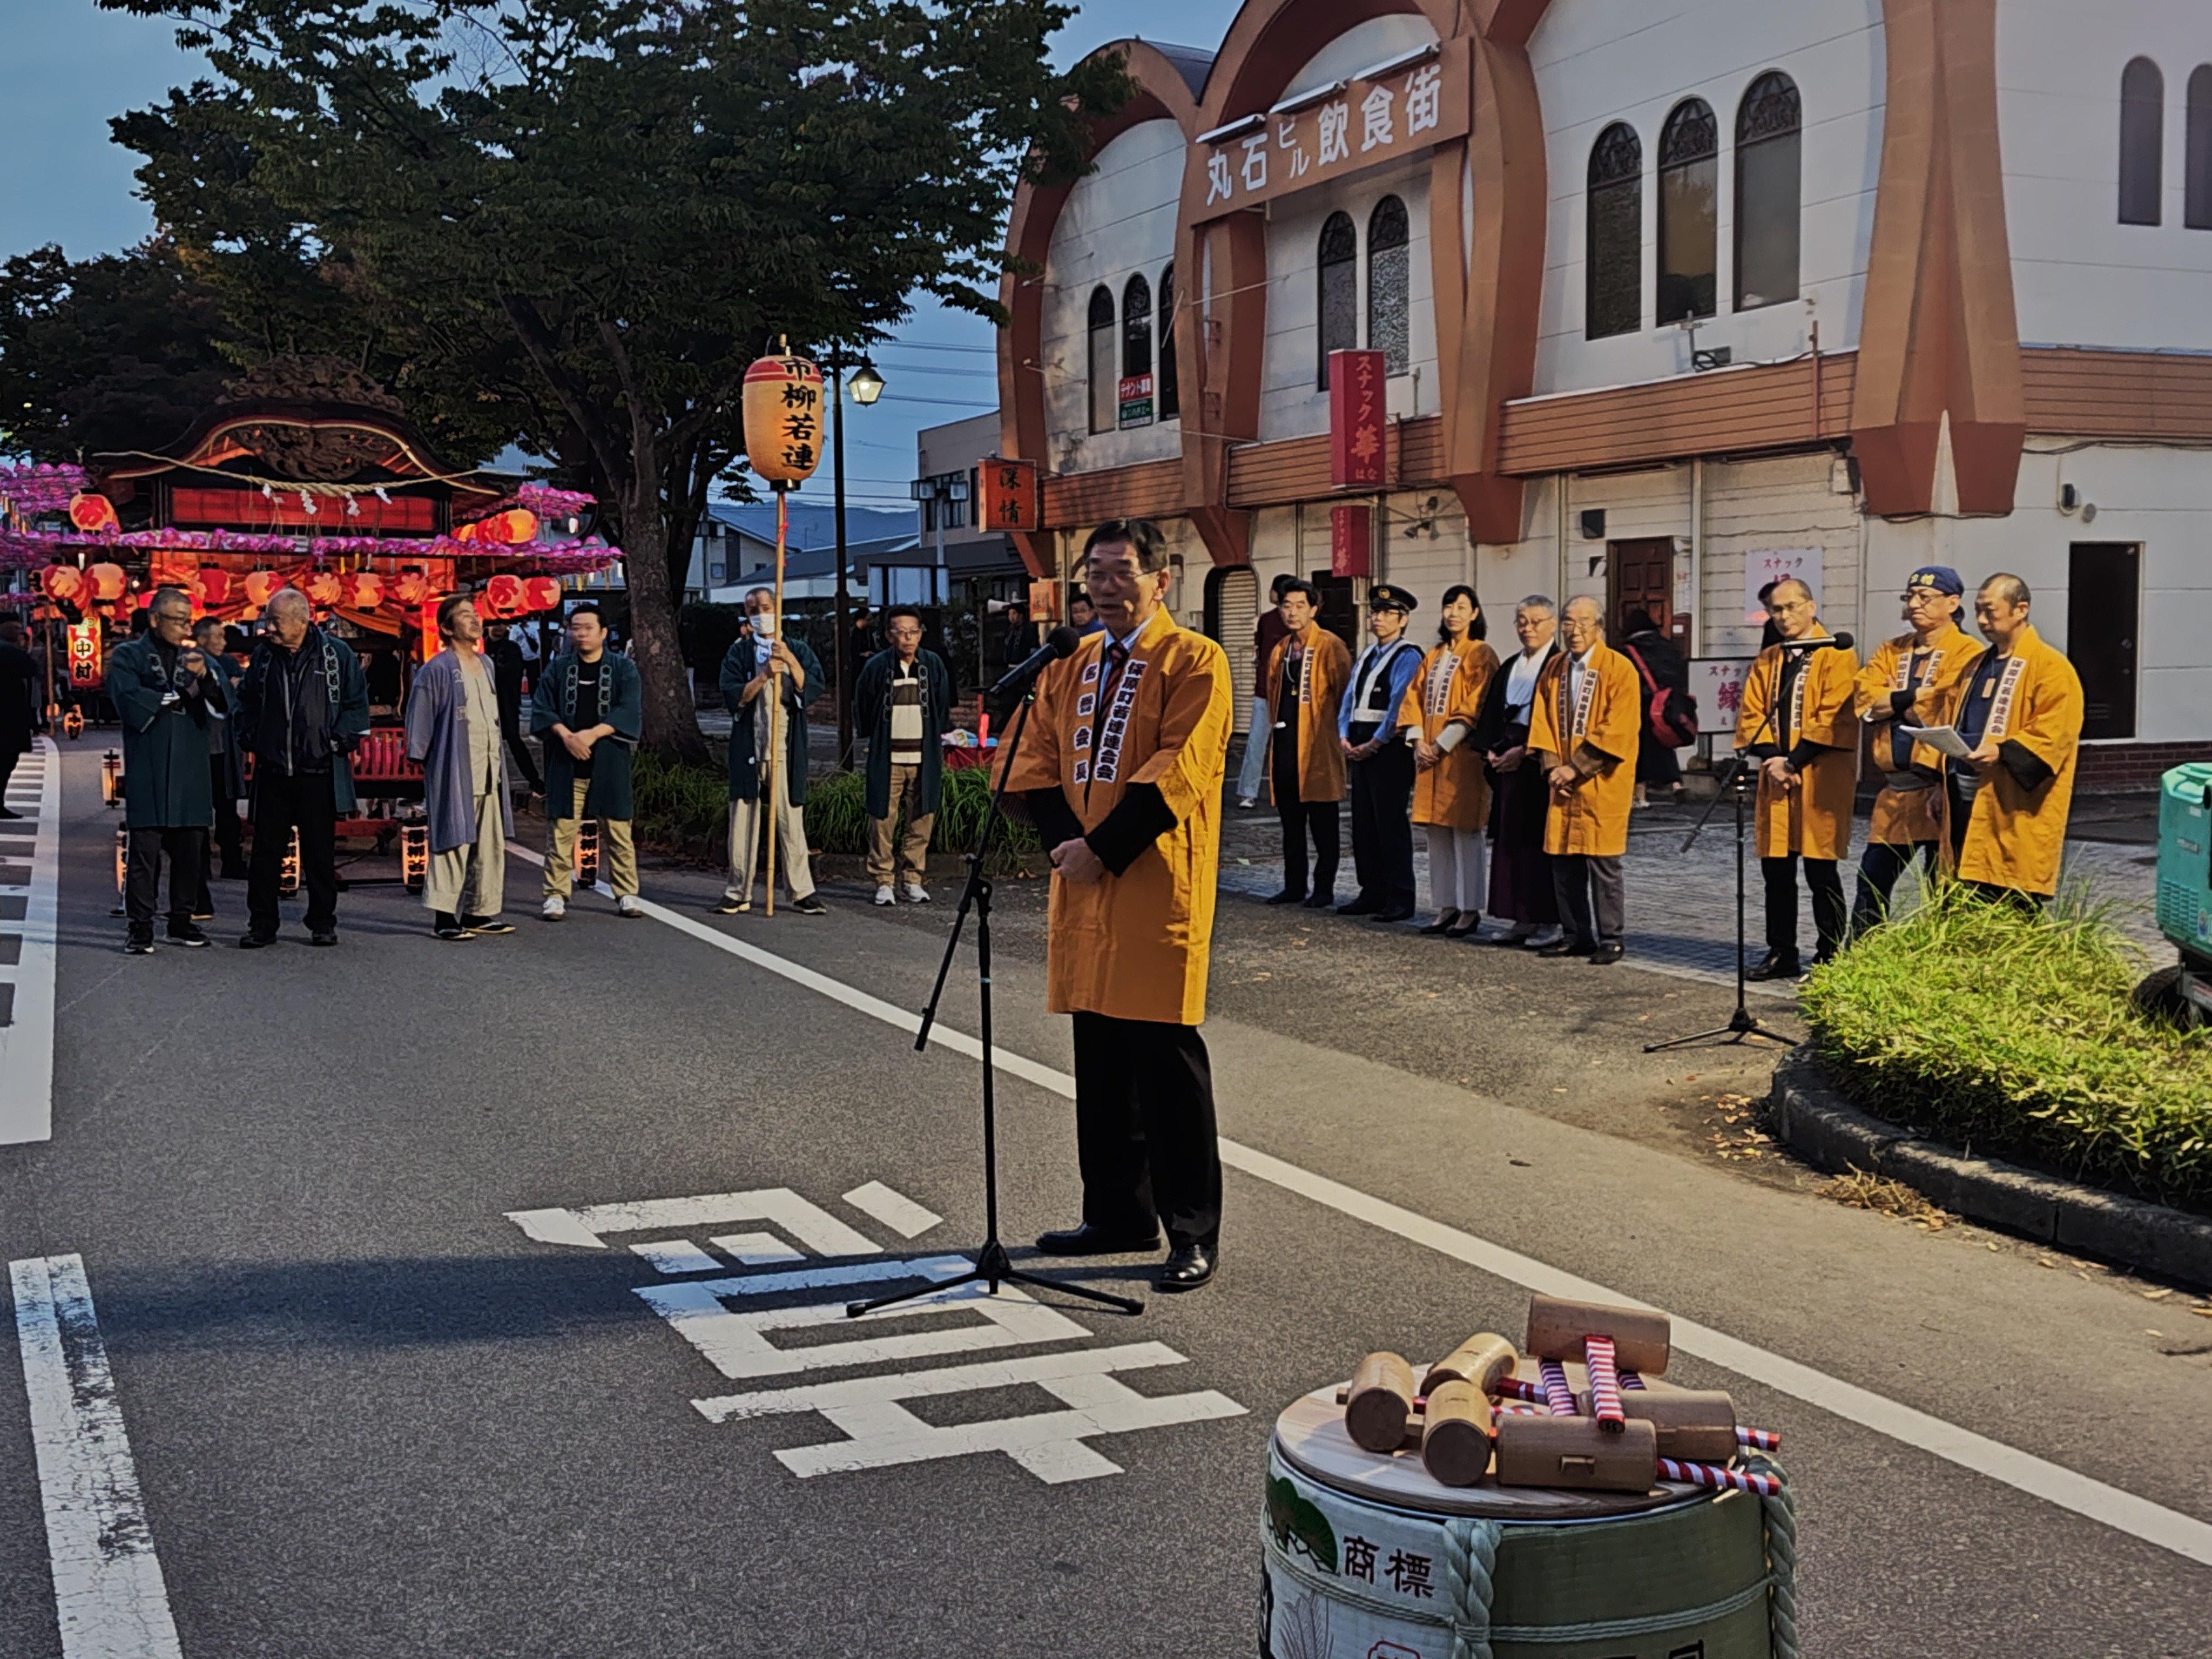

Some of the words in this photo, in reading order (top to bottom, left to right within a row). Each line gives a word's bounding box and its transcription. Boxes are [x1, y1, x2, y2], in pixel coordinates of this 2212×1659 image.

[780, 358, 817, 470] 市柳若連
[1350, 355, 1380, 466] スナック華
[999, 467, 1023, 524] 深情
[1354, 468, 1378, 481] はな
[1764, 557, 1803, 569] スナック
[75, 639, 92, 679] 中村
[1096, 662, 1147, 781] 保原町若連連合会
[1343, 1534, 1435, 1599] 商標
